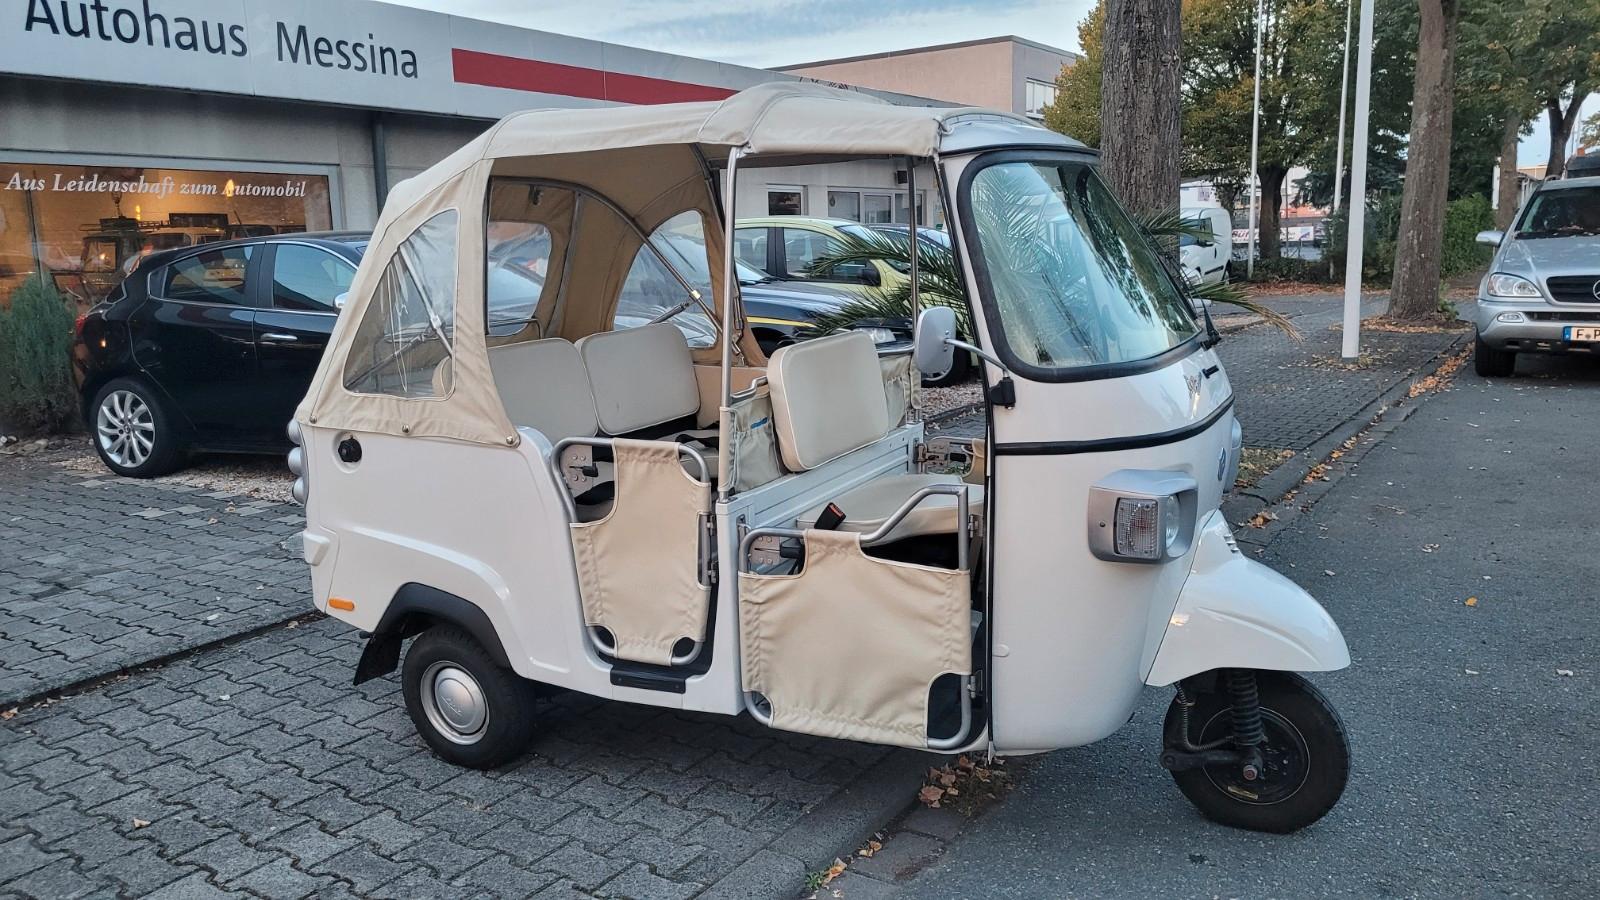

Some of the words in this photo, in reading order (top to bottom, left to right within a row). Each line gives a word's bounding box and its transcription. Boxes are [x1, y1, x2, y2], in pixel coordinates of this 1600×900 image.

[25, 0, 248, 57] Autohaus
[276, 21, 418, 79] Messina
[4, 171, 46, 191] Aus
[52, 173, 176, 199] Leidenschaft
[179, 182, 217, 195] zum
